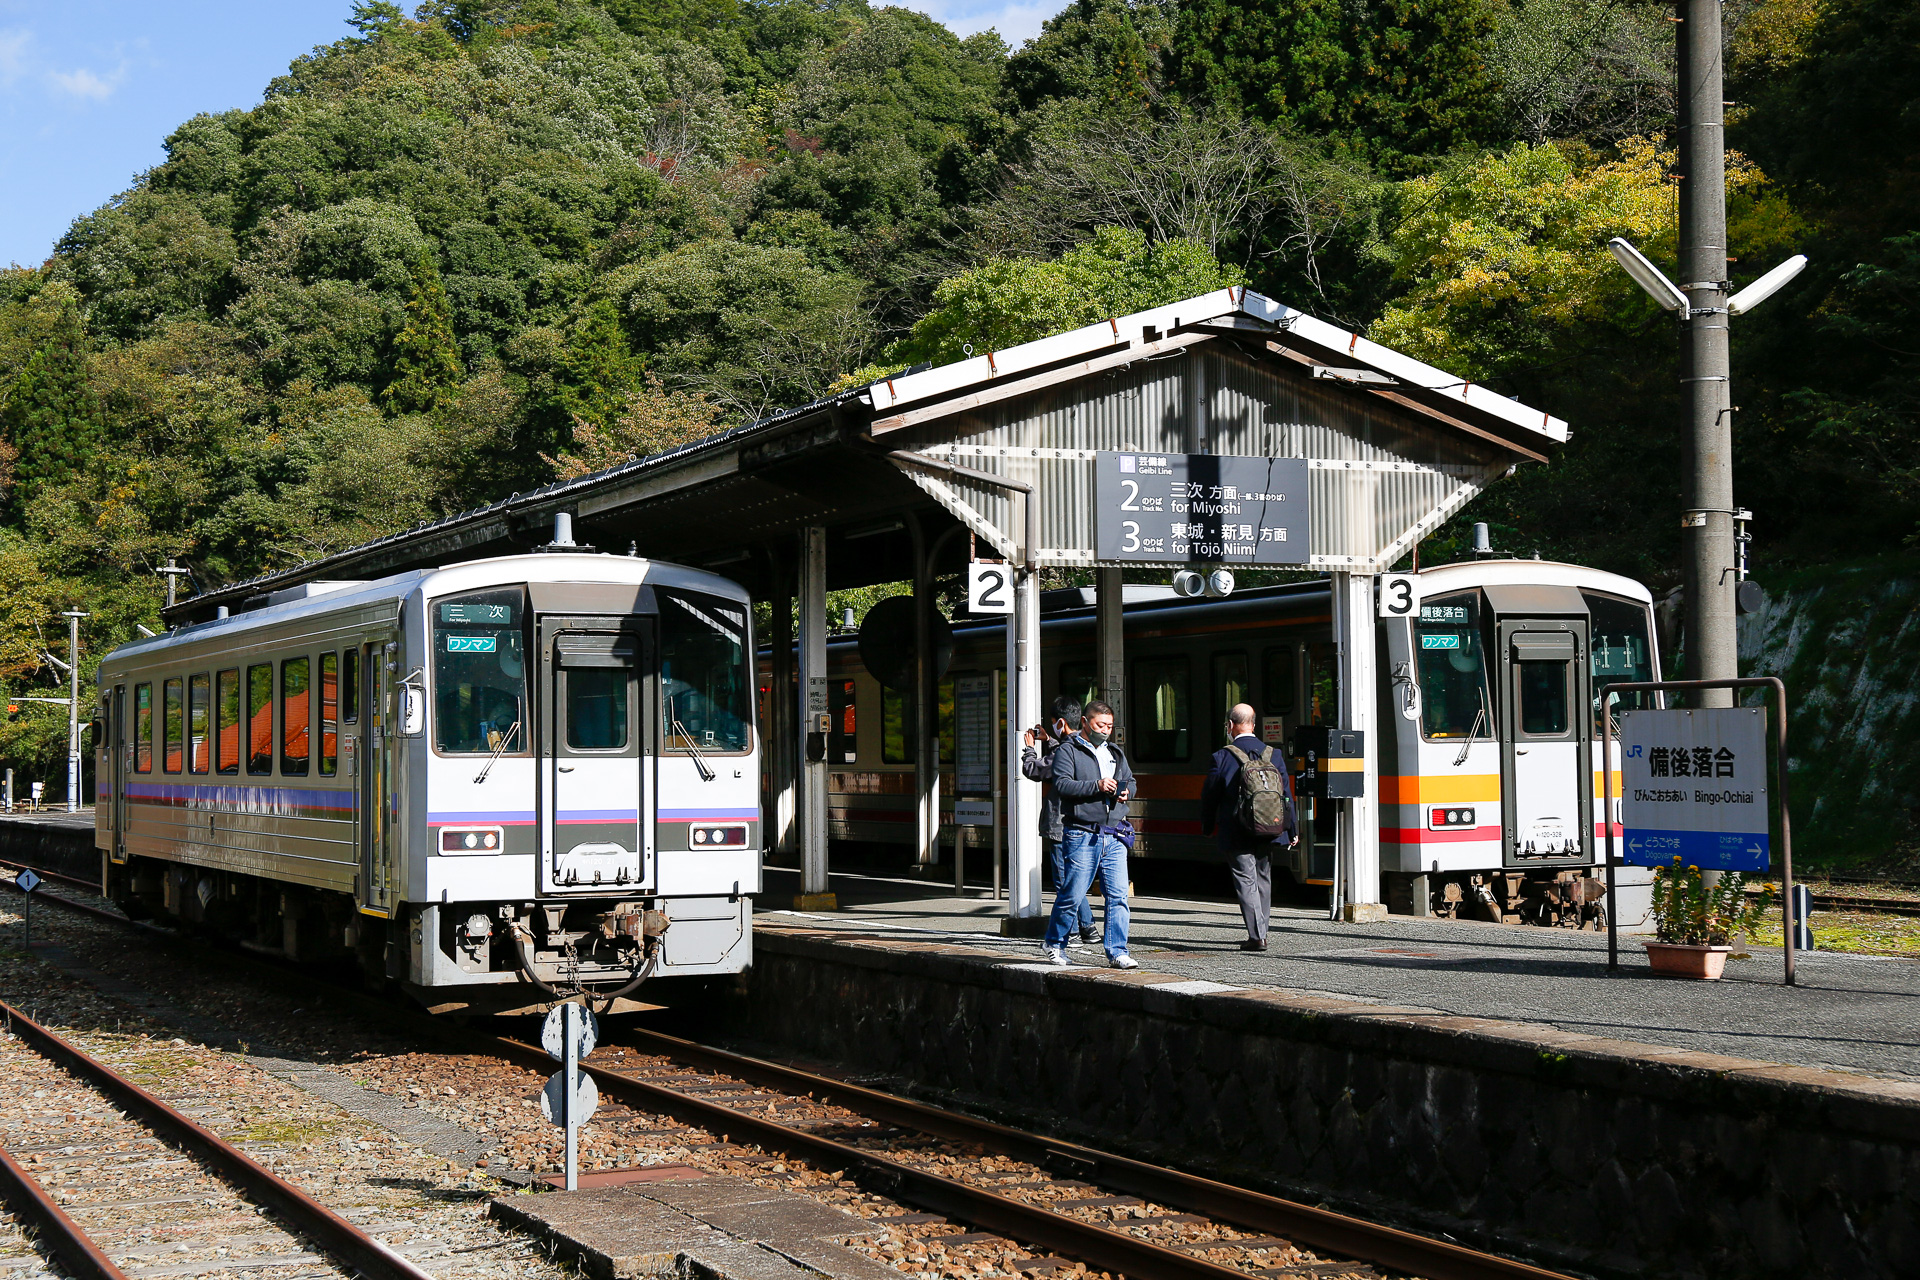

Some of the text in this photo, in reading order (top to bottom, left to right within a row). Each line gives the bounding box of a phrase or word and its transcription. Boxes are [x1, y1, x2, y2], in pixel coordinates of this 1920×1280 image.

[1138, 456, 1167, 467] 芸備線
[1138, 466, 1173, 475] Geibi Line
[1120, 479, 1140, 512] 2
[1169, 481, 1204, 499] 三次
[1208, 485, 1238, 500] 方面
[1141, 497, 1163, 505] のりば
[1171, 500, 1241, 517] for Miyoshi
[1121, 520, 1141, 553] 3
[1259, 527, 1288, 542] 方面
[1142, 538, 1164, 546] のりば
[1171, 541, 1191, 555] for
[977, 570, 1005, 606] 2
[1387, 578, 1413, 615] 3
[1421, 606, 1465, 618] 備後落合
[449, 638, 495, 651] ワンマン
[1423, 637, 1458, 648] ワンマン
[1626, 744, 1643, 758] JR
[1649, 746, 1736, 778] 備後落合
[1634, 788, 1754, 806] びんごおちあい Bingo-Ochiai
[25, 874, 30, 887] 1
